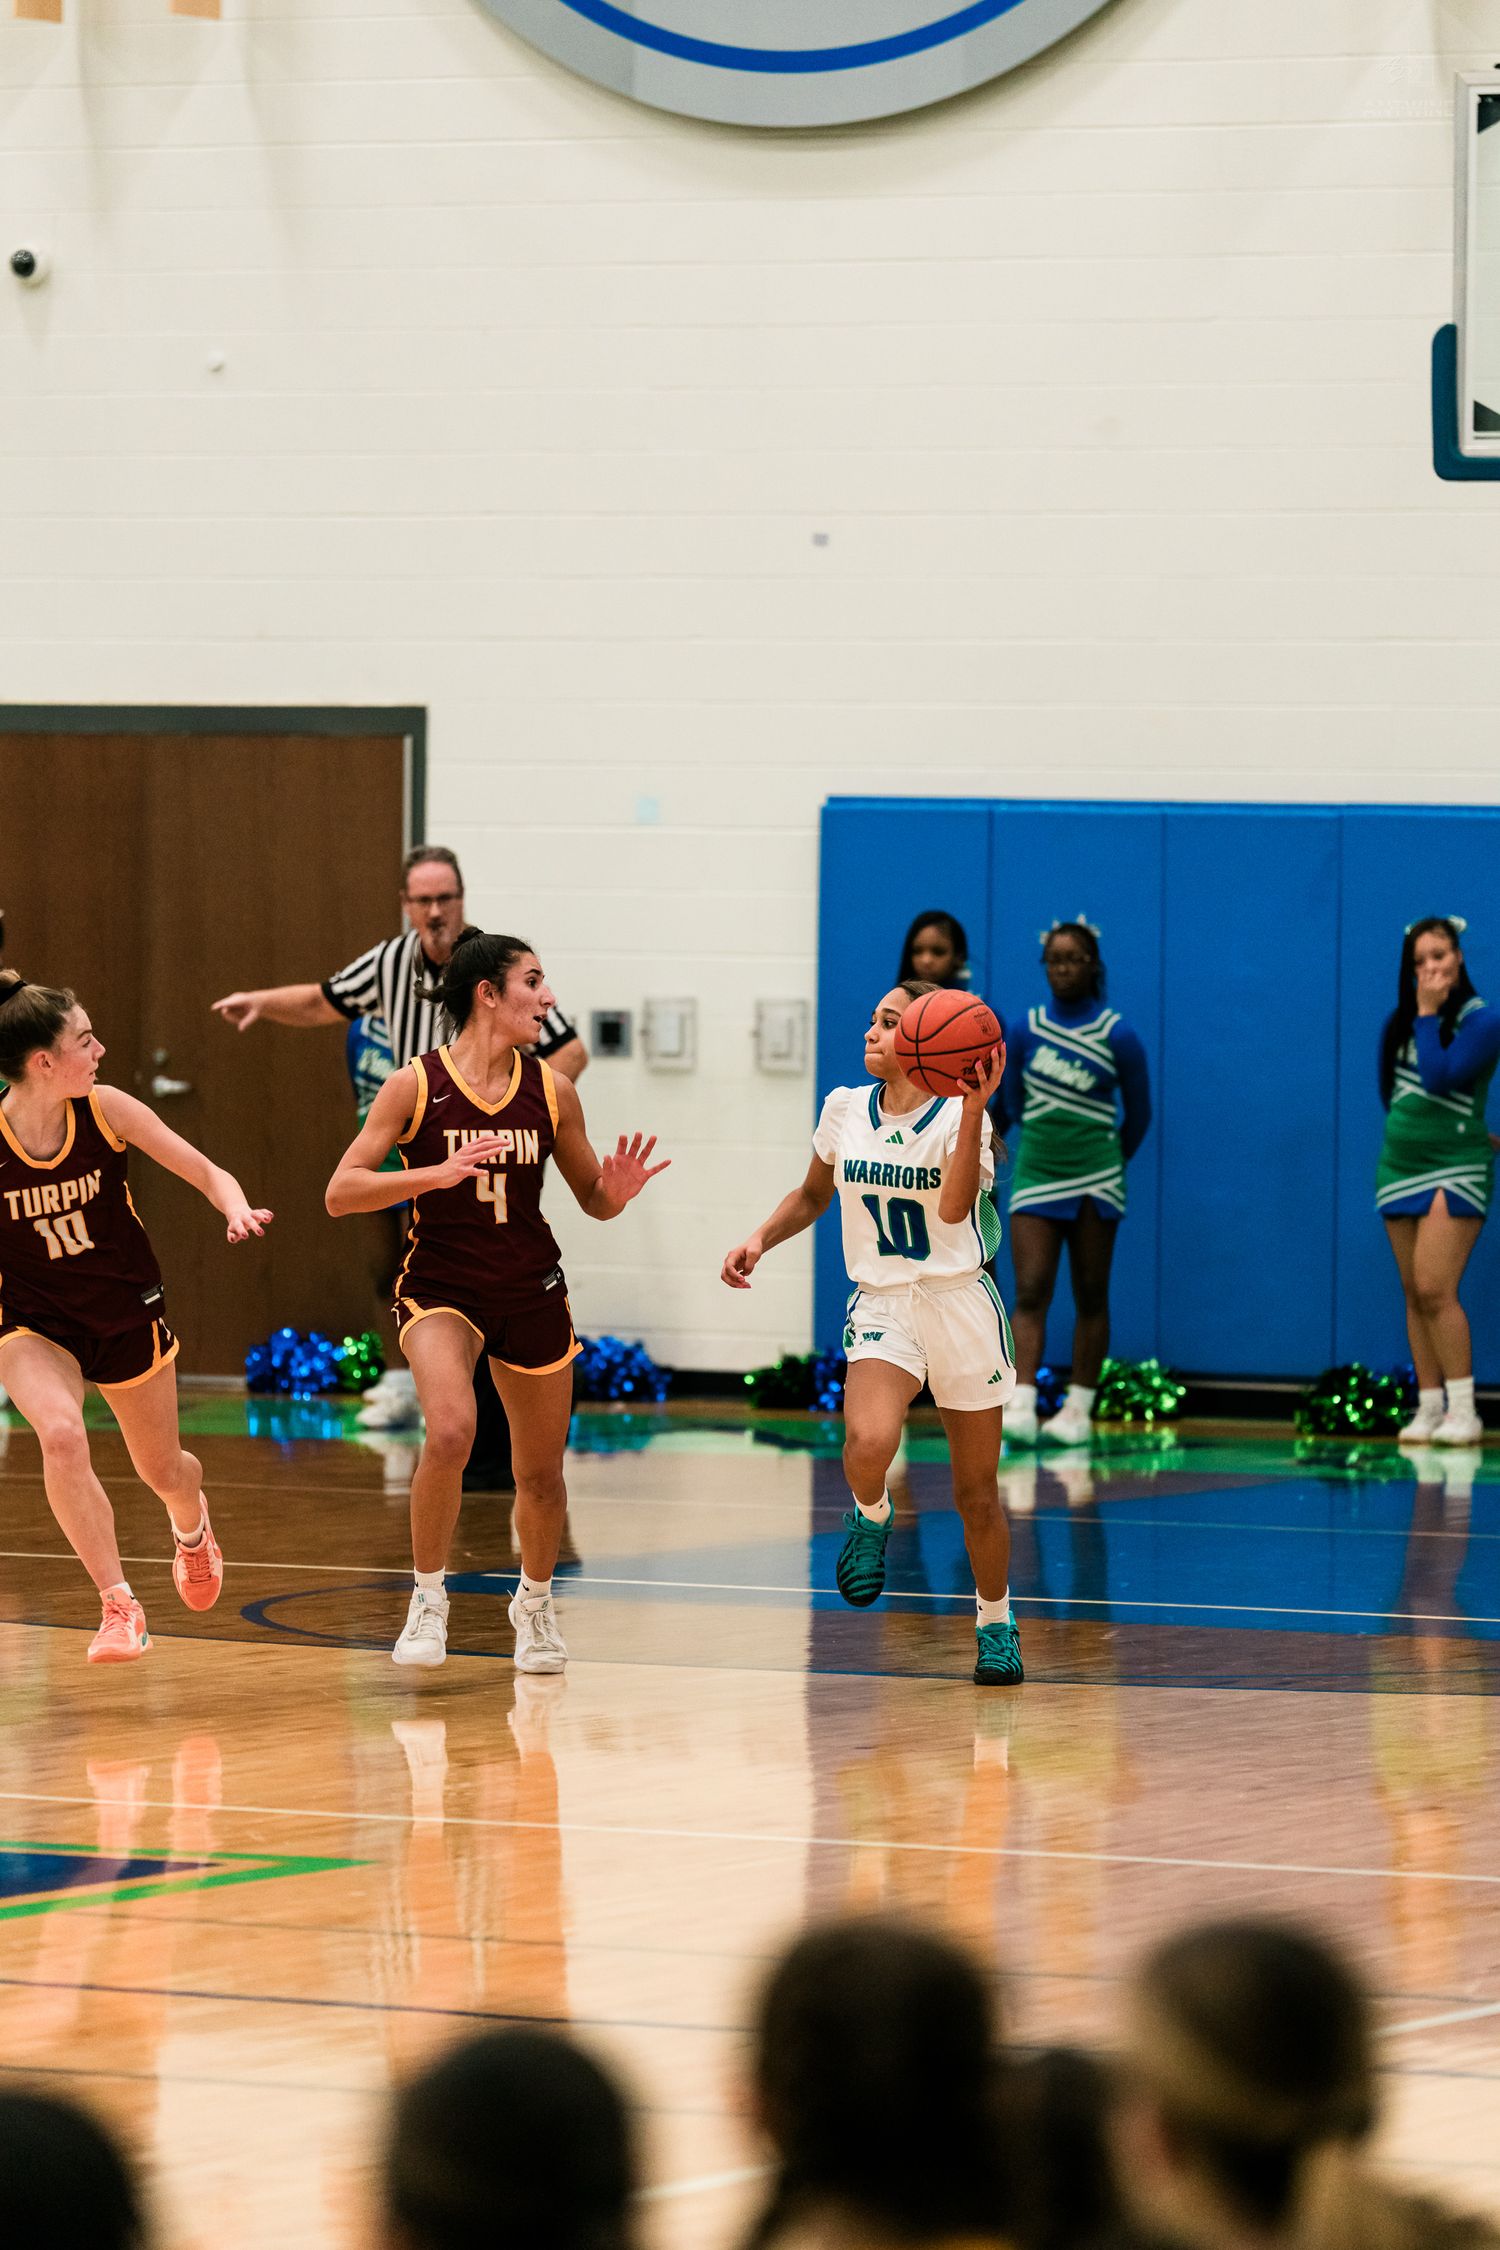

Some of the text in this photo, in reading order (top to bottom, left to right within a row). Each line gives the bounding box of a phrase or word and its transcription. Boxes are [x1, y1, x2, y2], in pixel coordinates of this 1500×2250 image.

[3, 1169, 101, 1220] TURPIN
[476, 1172, 508, 1224] 4
[844, 1159, 941, 1190] WARRIORS
[33, 1210, 95, 1260] 10
[861, 1194, 931, 1261] 10
